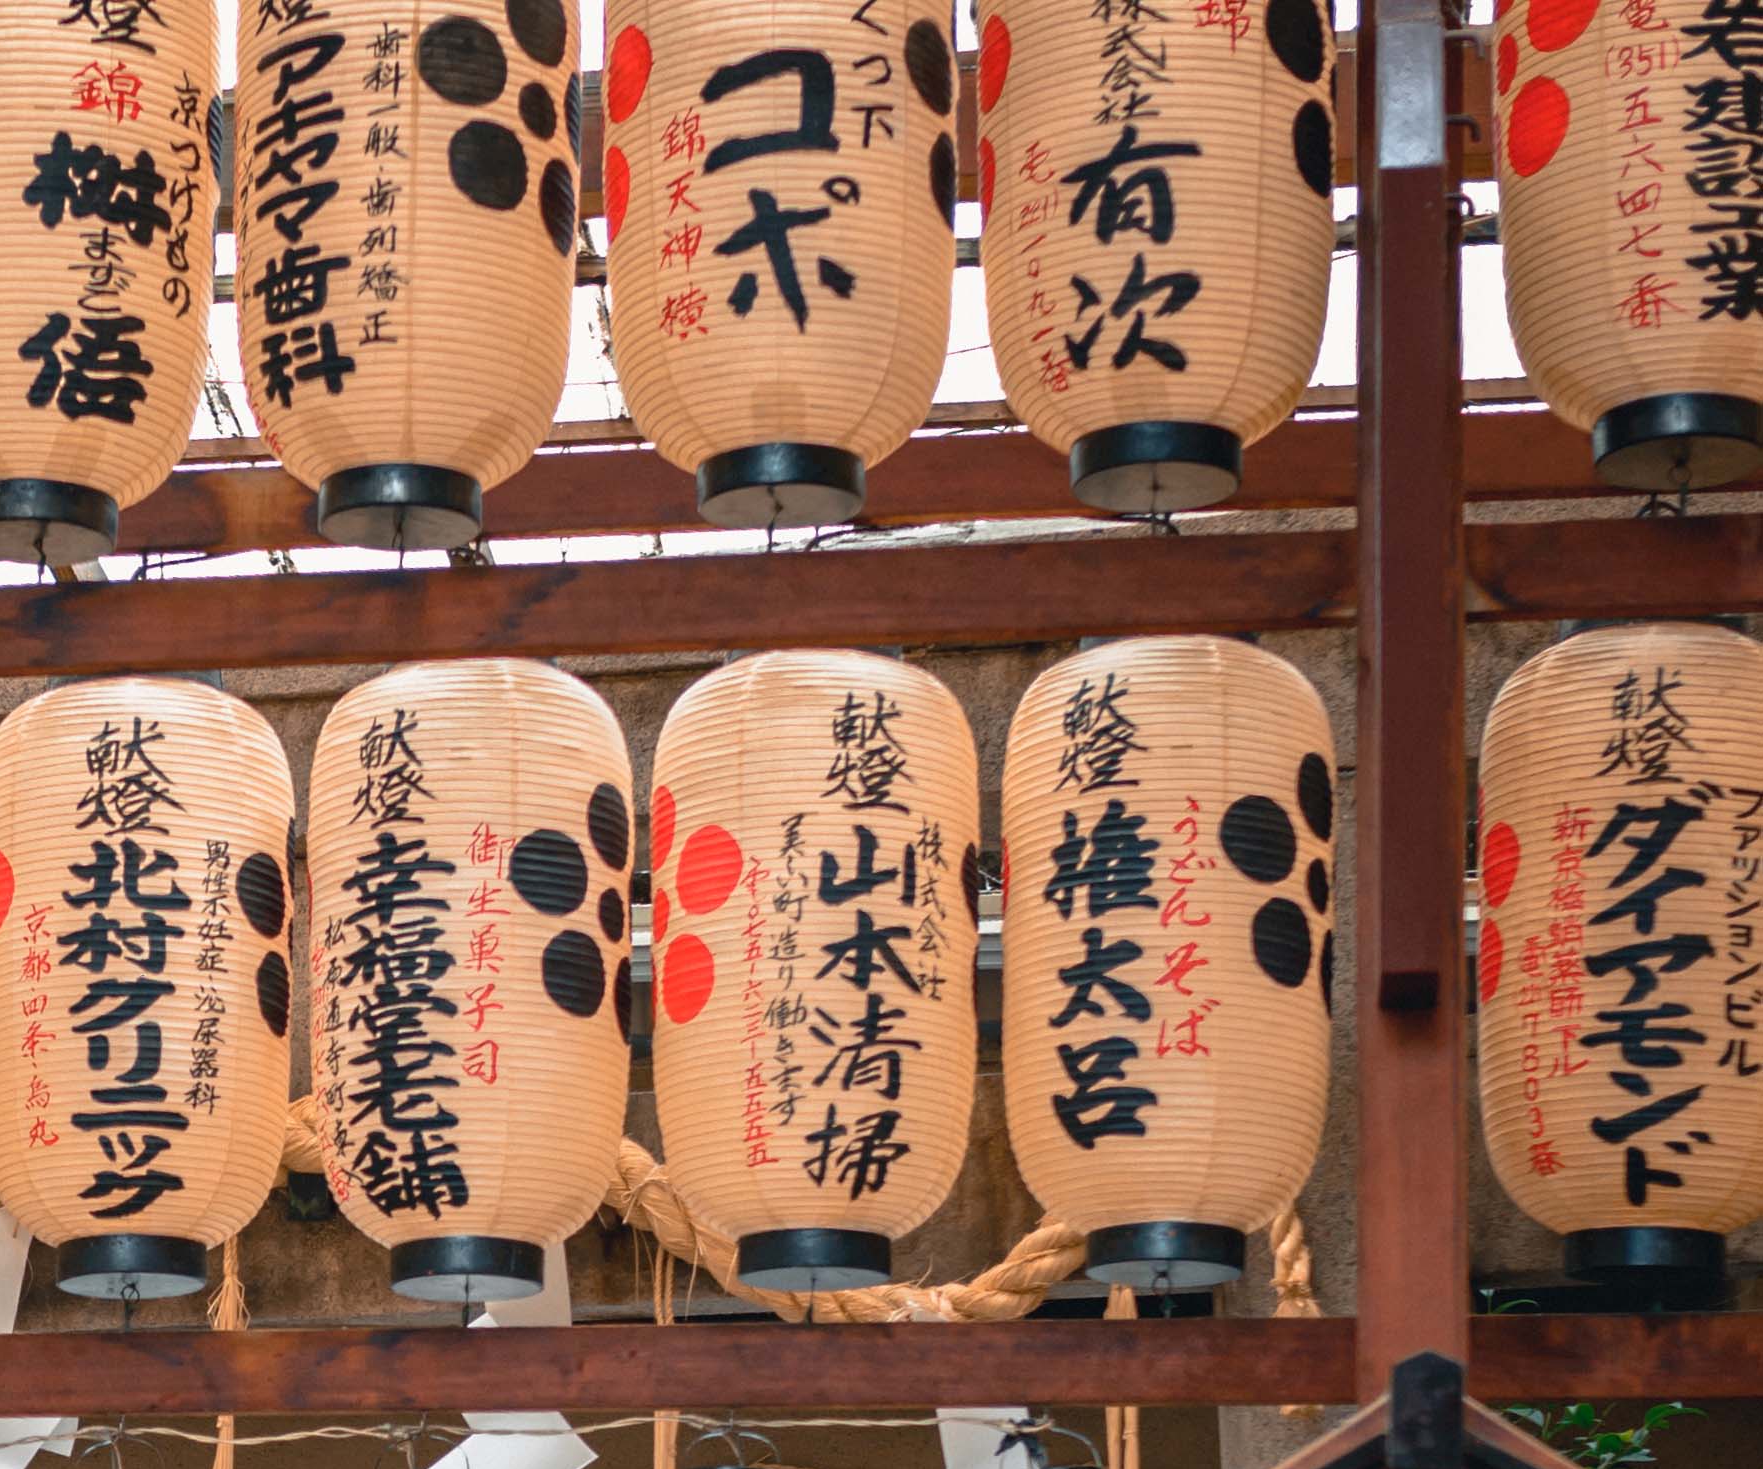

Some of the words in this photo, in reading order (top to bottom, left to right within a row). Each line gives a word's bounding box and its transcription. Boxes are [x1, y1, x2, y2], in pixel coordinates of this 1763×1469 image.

[70, 61, 144, 124] 錦
[162, 70, 203, 319] 京つけもの
[356, 21, 411, 346] 歯科一般・歯列矯正
[699, 48, 862, 335] コポ
[253, 33, 357, 410] アキヤマ歯科
[659, 105, 710, 342] 錦天神横
[1060, 124, 1203, 372] 有次
[75, 716, 187, 837] 献燈
[349, 708, 436, 829] 献燈
[820, 691, 918, 815] 献燈
[1053, 671, 1148, 794] 献燈
[1595, 666, 1705, 785] 献燈
[56, 837, 193, 1220] 北村クリニック
[341, 831, 470, 1220] 幸福堂老舗
[461, 820, 516, 1086] 御生菓子司
[802, 823, 921, 1200] 山本清掃
[915, 814, 949, 1002] 株式会社
[1578, 779, 1727, 1207] ダイアモンド
